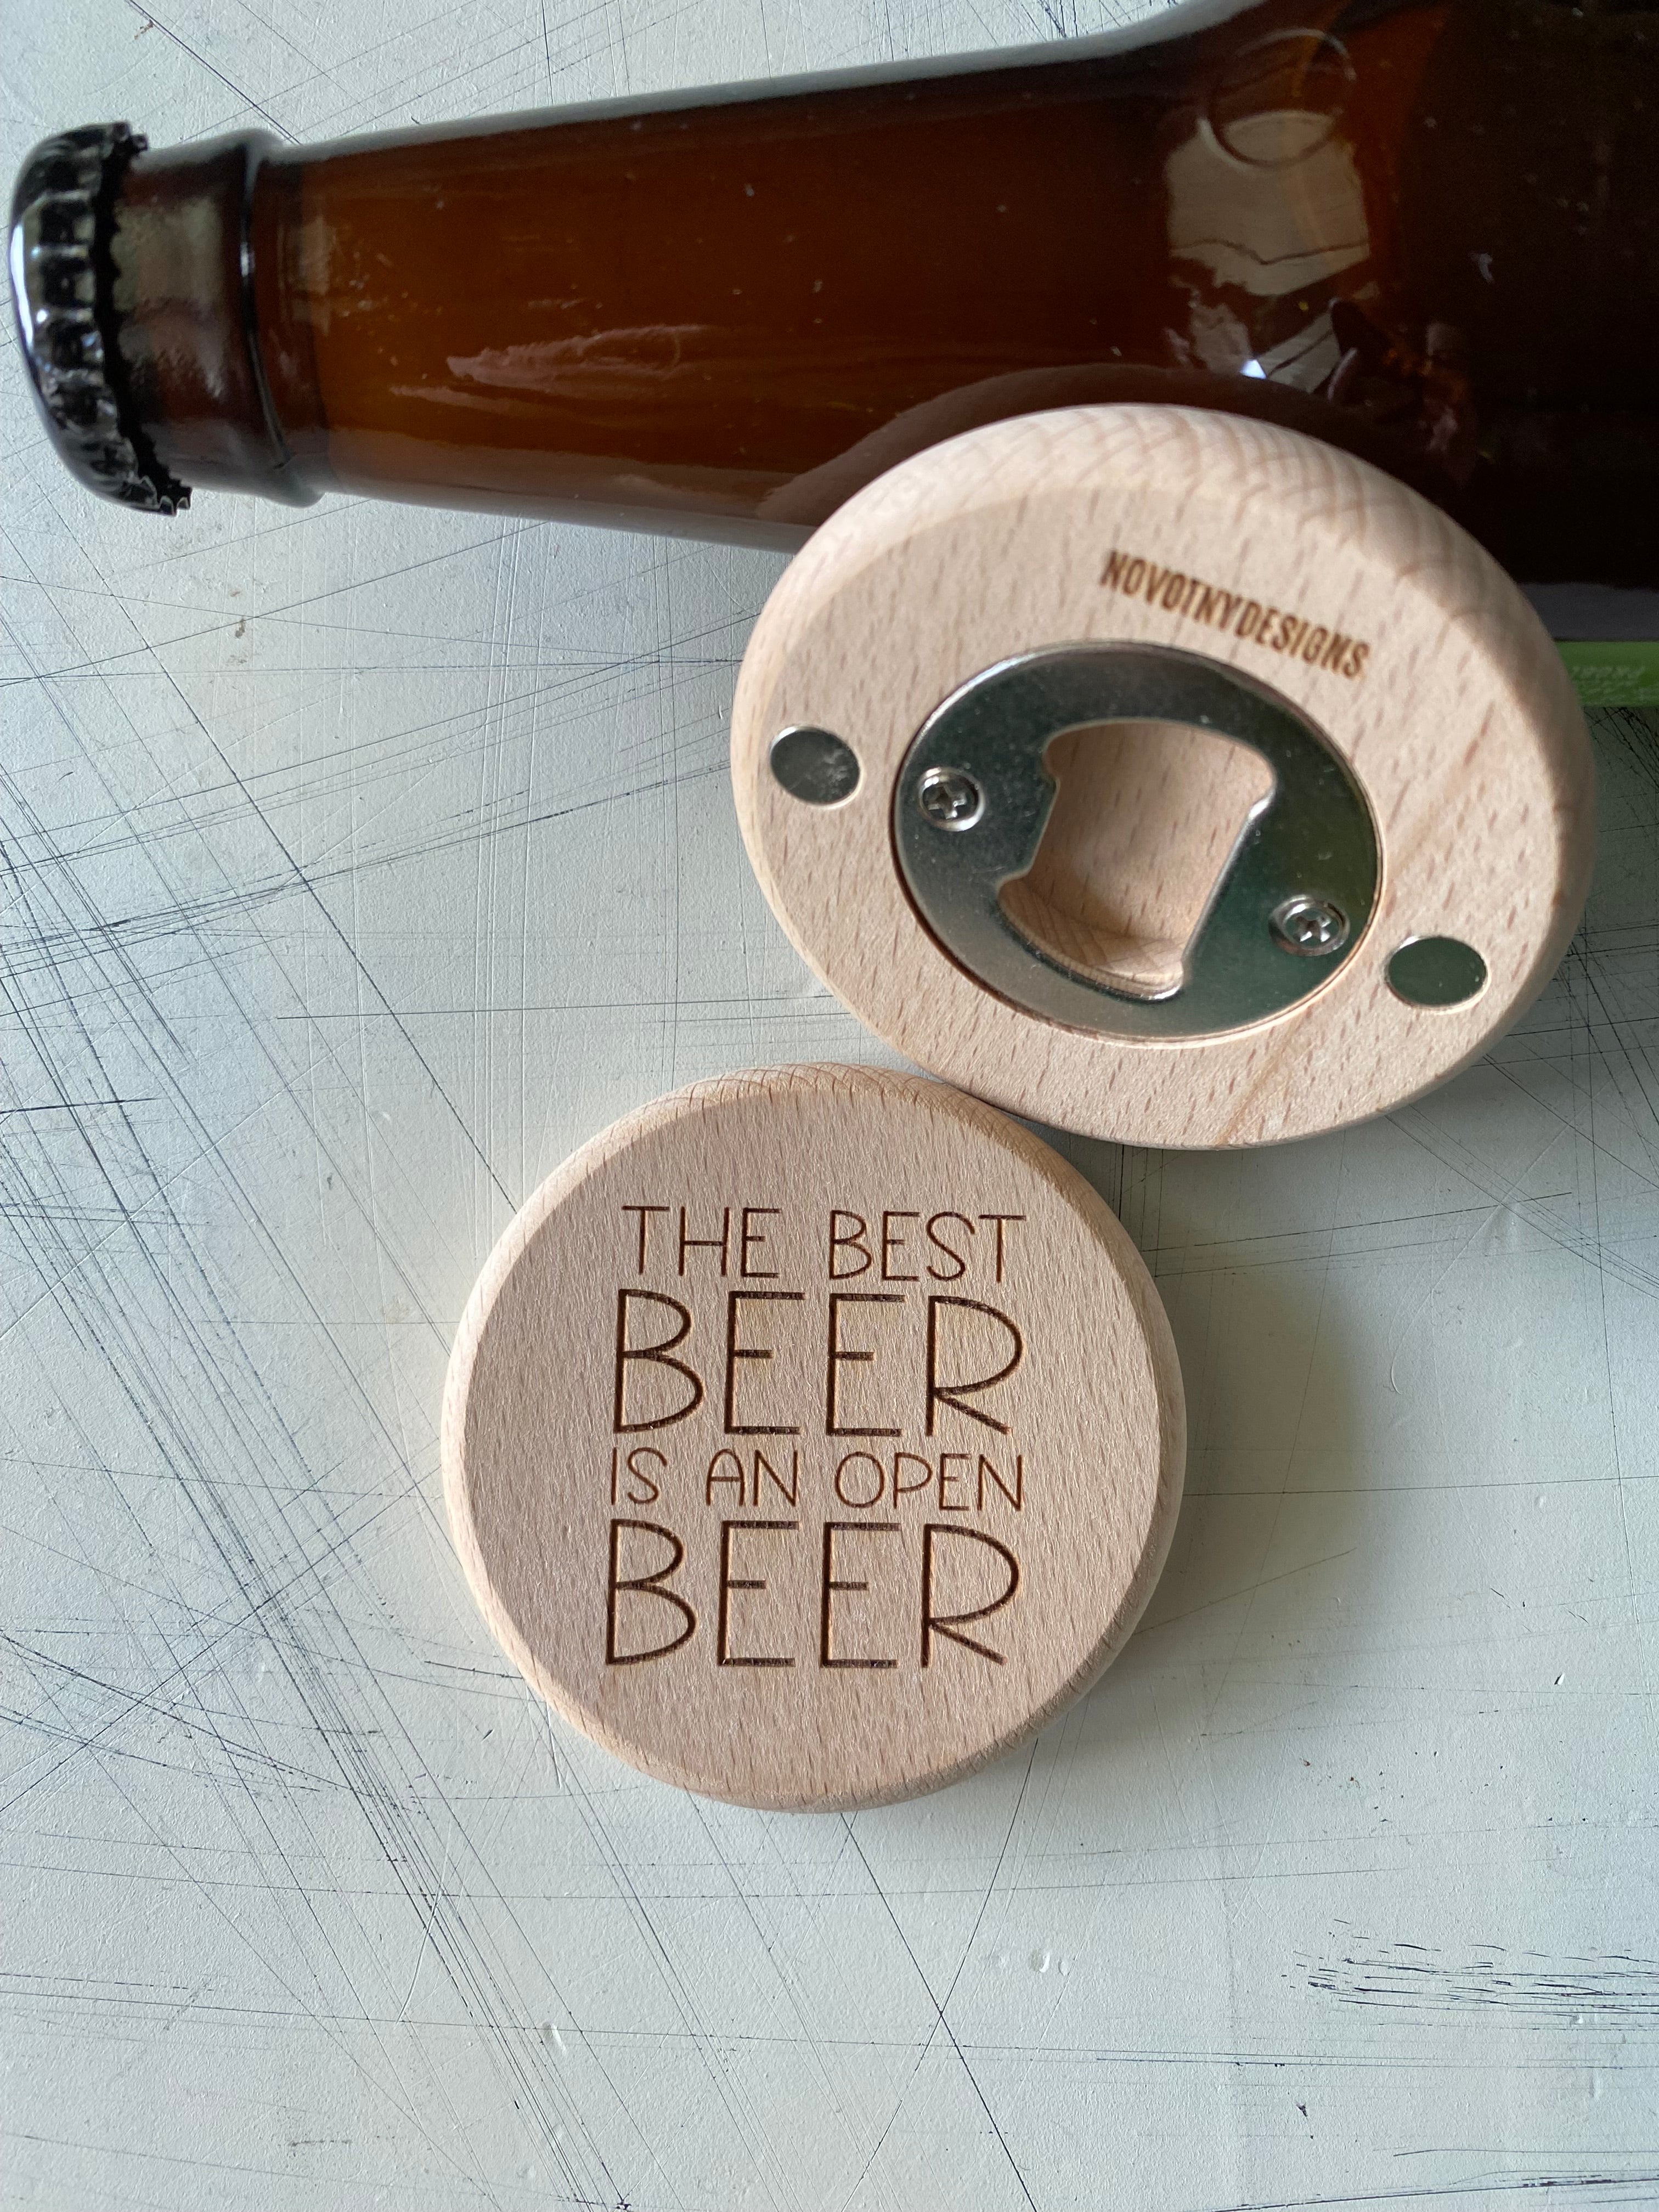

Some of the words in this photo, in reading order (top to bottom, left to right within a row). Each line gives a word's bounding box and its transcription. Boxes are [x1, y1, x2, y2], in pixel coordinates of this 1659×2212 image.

[1099, 550, 1369, 678] NOVOTNYDESIGNS
[622, 1205, 781, 1278] THE
[829, 1209, 1026, 1283] BEST
[613, 1288, 1025, 1437] BEER
[611, 1446, 668, 1505] IS
[706, 1448, 799, 1506] AN
[834, 1450, 1024, 1511] OPEN
[606, 1518, 1021, 1668] BEER
